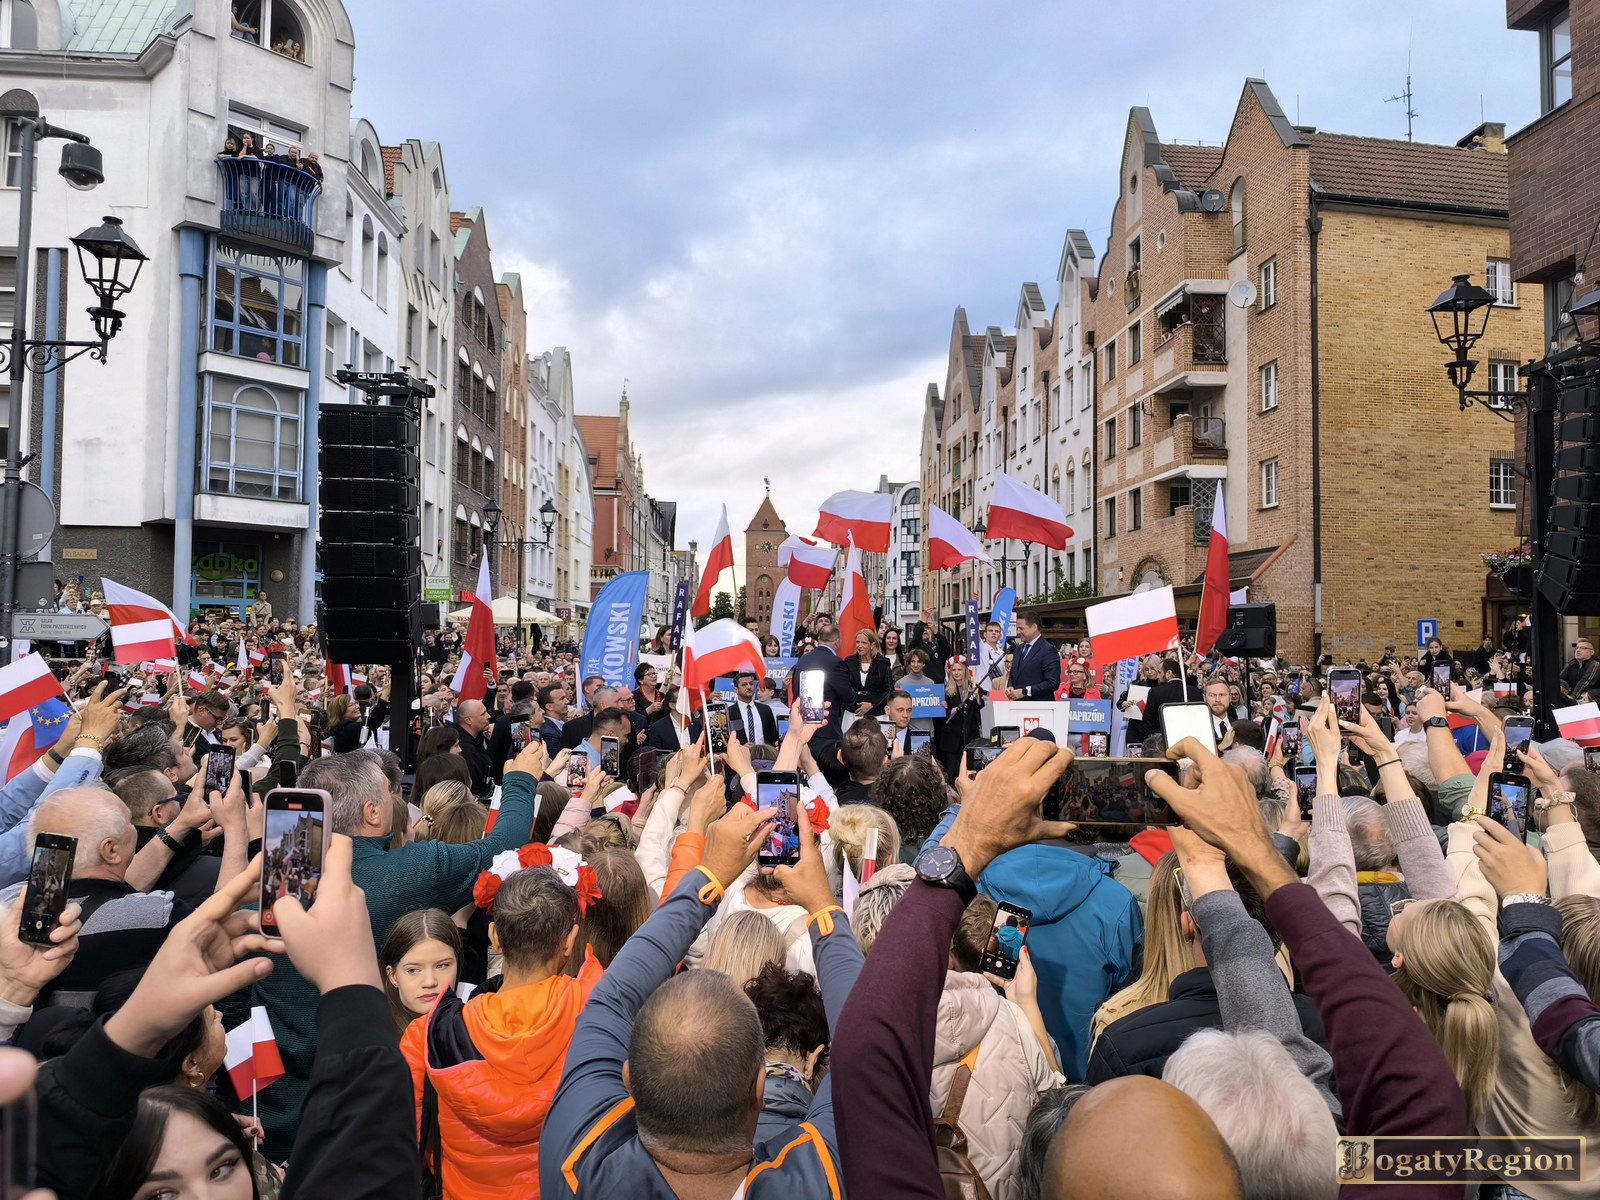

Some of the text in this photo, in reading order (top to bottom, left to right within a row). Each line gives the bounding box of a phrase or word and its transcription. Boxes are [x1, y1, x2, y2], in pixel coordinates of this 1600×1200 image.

[673, 588, 685, 646] RAFAŁ
[968, 605, 977, 661] RAFAŁ
[1421, 622, 1433, 644] P
[587, 657, 600, 676] FAŁ
[912, 693, 941, 707] APRZÓD!
